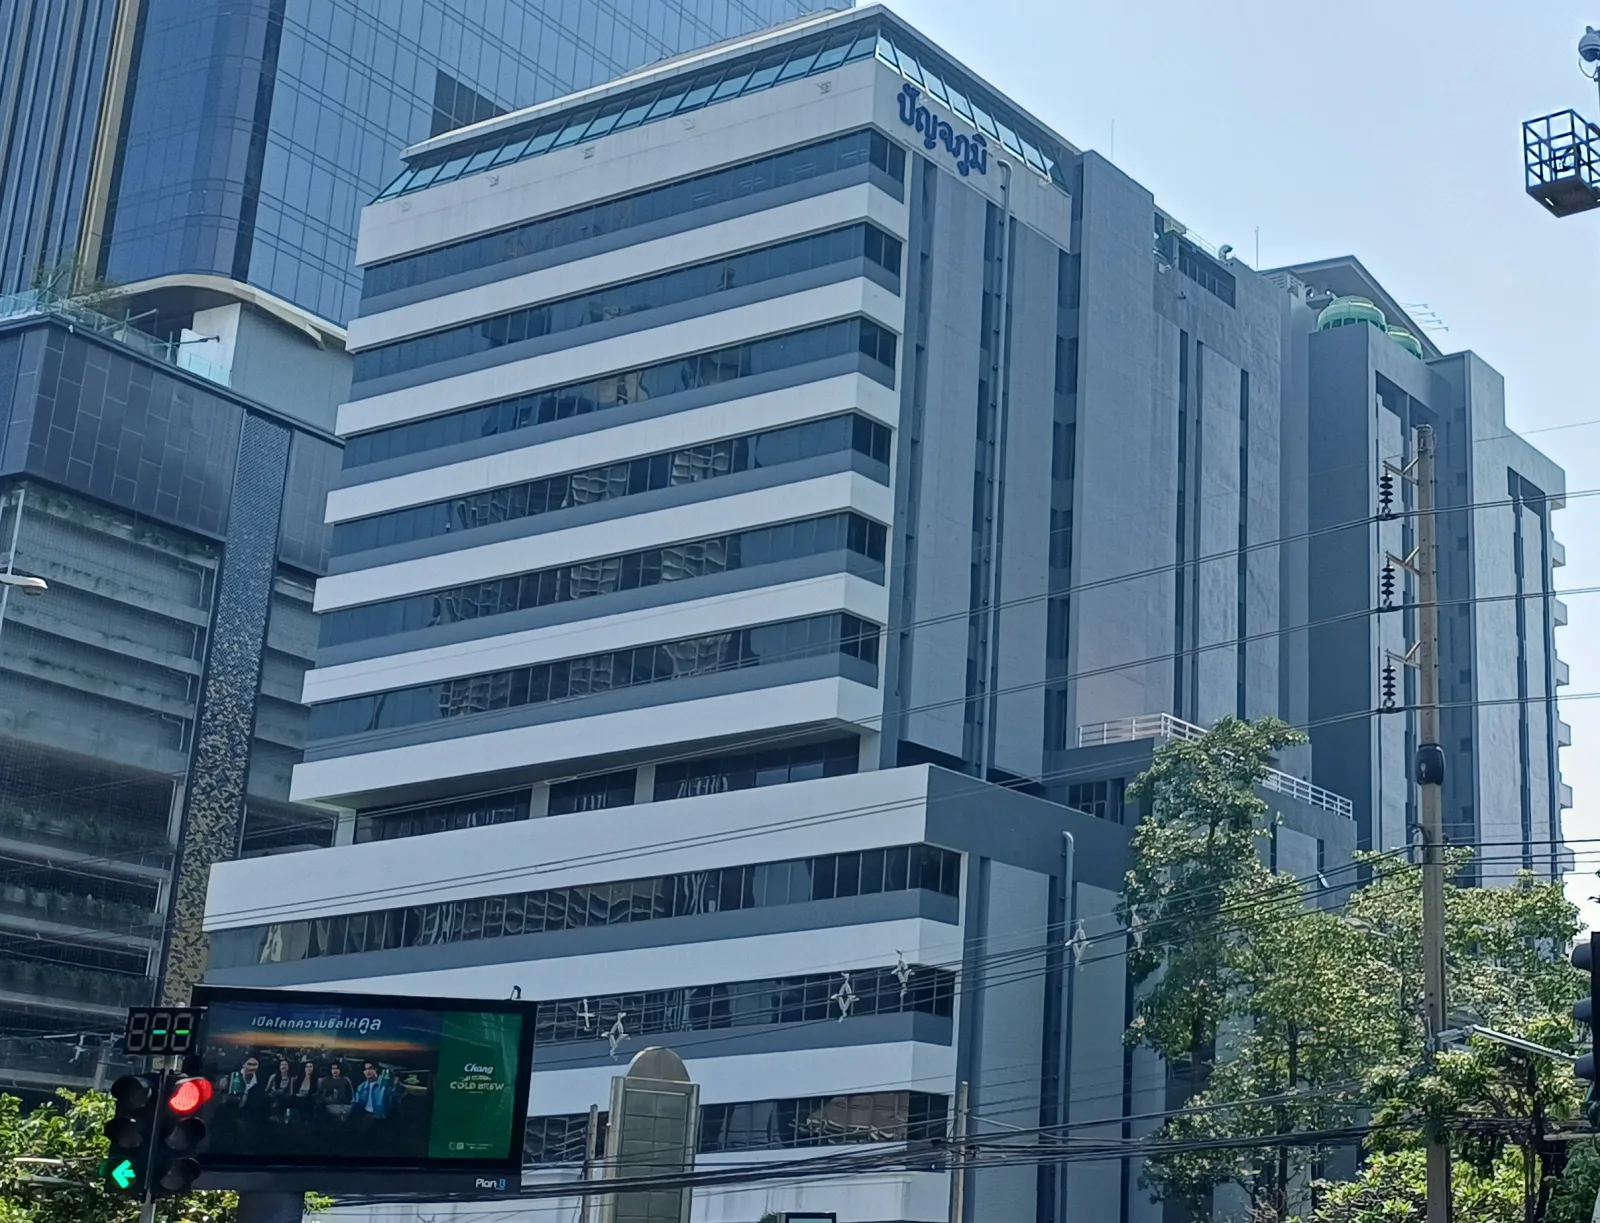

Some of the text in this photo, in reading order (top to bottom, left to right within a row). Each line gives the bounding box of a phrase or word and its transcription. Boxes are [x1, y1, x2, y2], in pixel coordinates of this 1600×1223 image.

[897, 83, 987, 177] ปัญจภูมิ
[464, 1063, 494, 1074] Chang
[449, 1081, 504, 1091] COLD BREW
[475, 1178, 497, 1188] Plan
